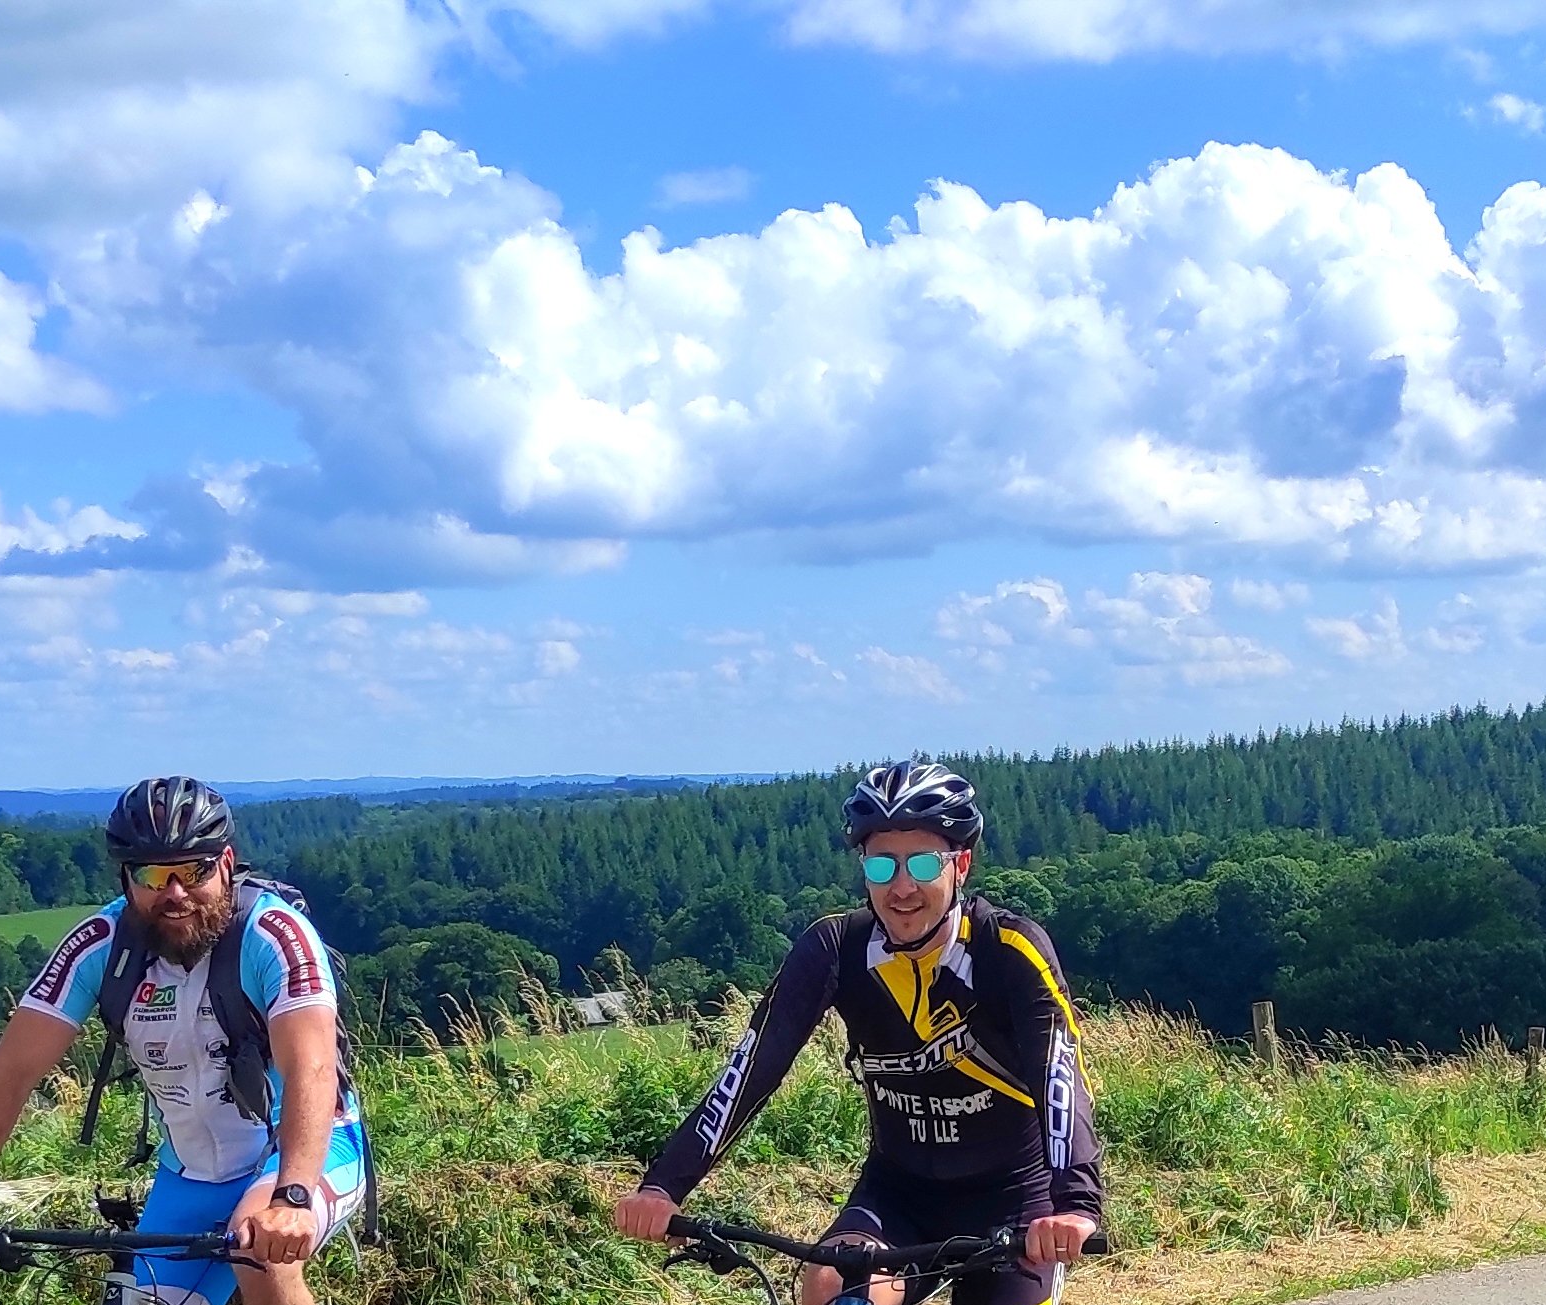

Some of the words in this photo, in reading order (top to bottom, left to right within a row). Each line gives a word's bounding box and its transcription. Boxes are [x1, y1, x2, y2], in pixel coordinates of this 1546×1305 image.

[32, 923, 99, 1001] CHAMBERET
[701, 1027, 757, 1157] SCOTT
[863, 1023, 968, 1073] SCOTT
[1047, 1028, 1075, 1170] SCOTT
